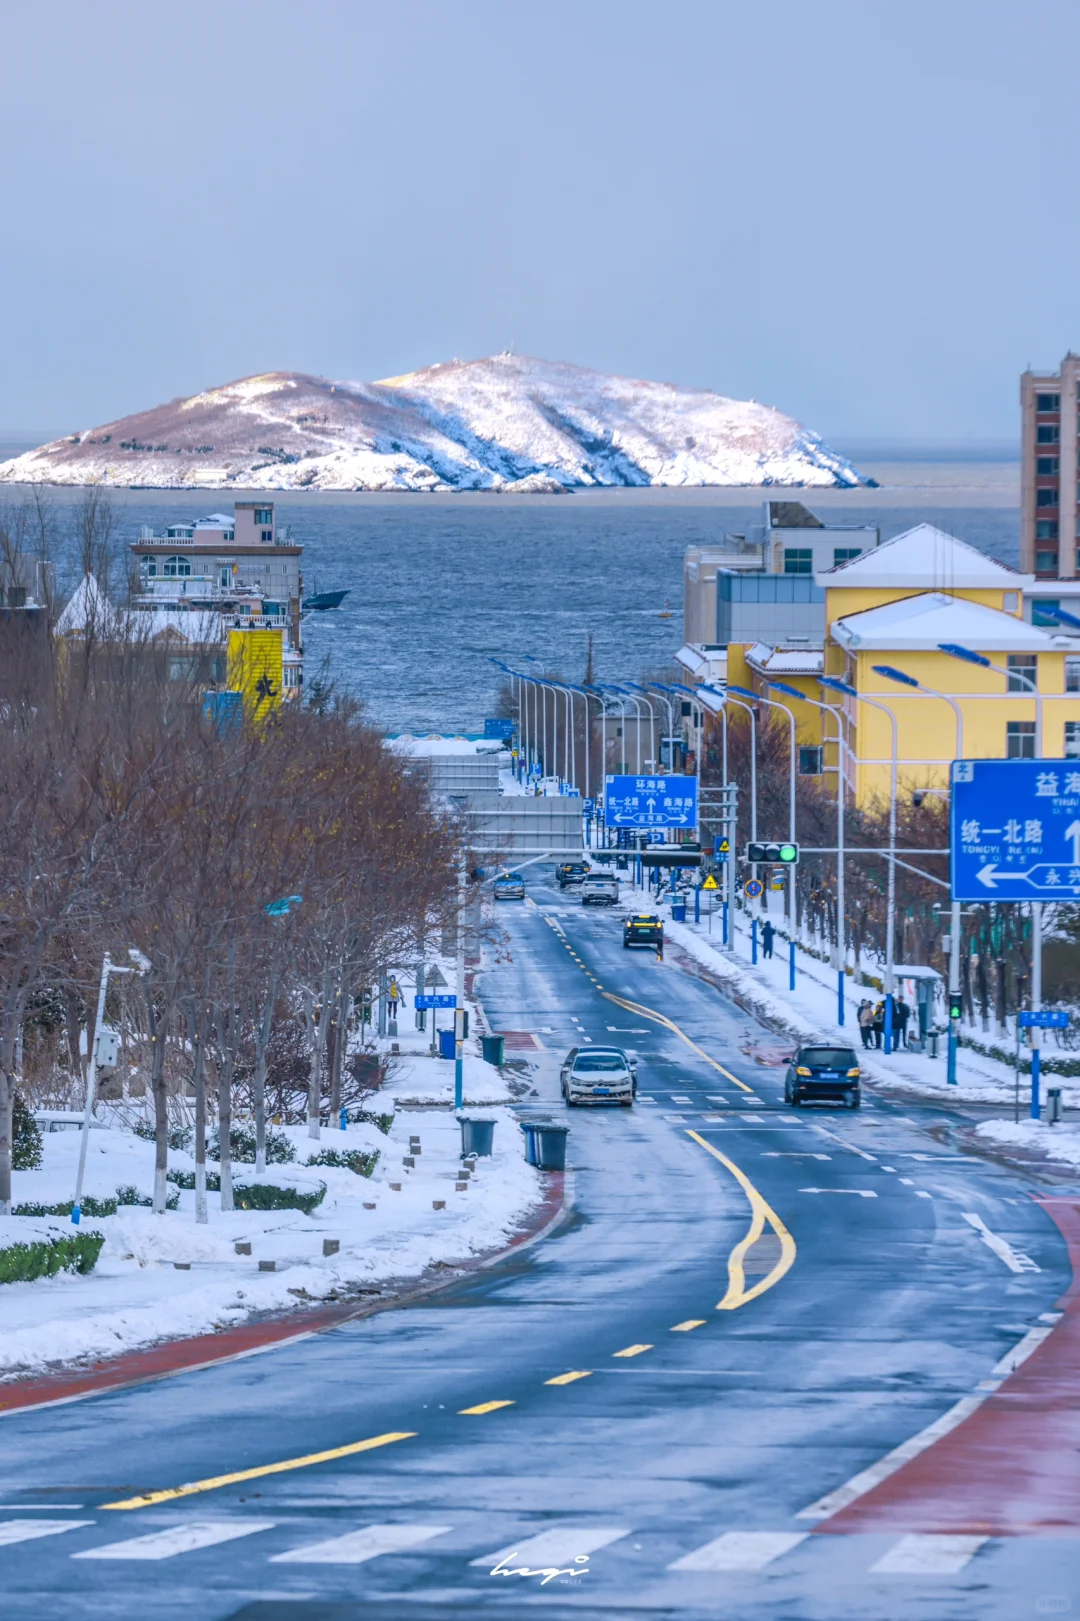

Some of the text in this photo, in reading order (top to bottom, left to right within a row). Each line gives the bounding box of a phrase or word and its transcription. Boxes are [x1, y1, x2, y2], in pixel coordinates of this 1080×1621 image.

[636, 779, 666, 789] 环海路
[608, 797, 639, 806] 统一北路
[663, 797, 693, 807] 鑫海路
[961, 819, 1043, 843] 统一北路
[962, 845, 1000, 853] TONGYI
